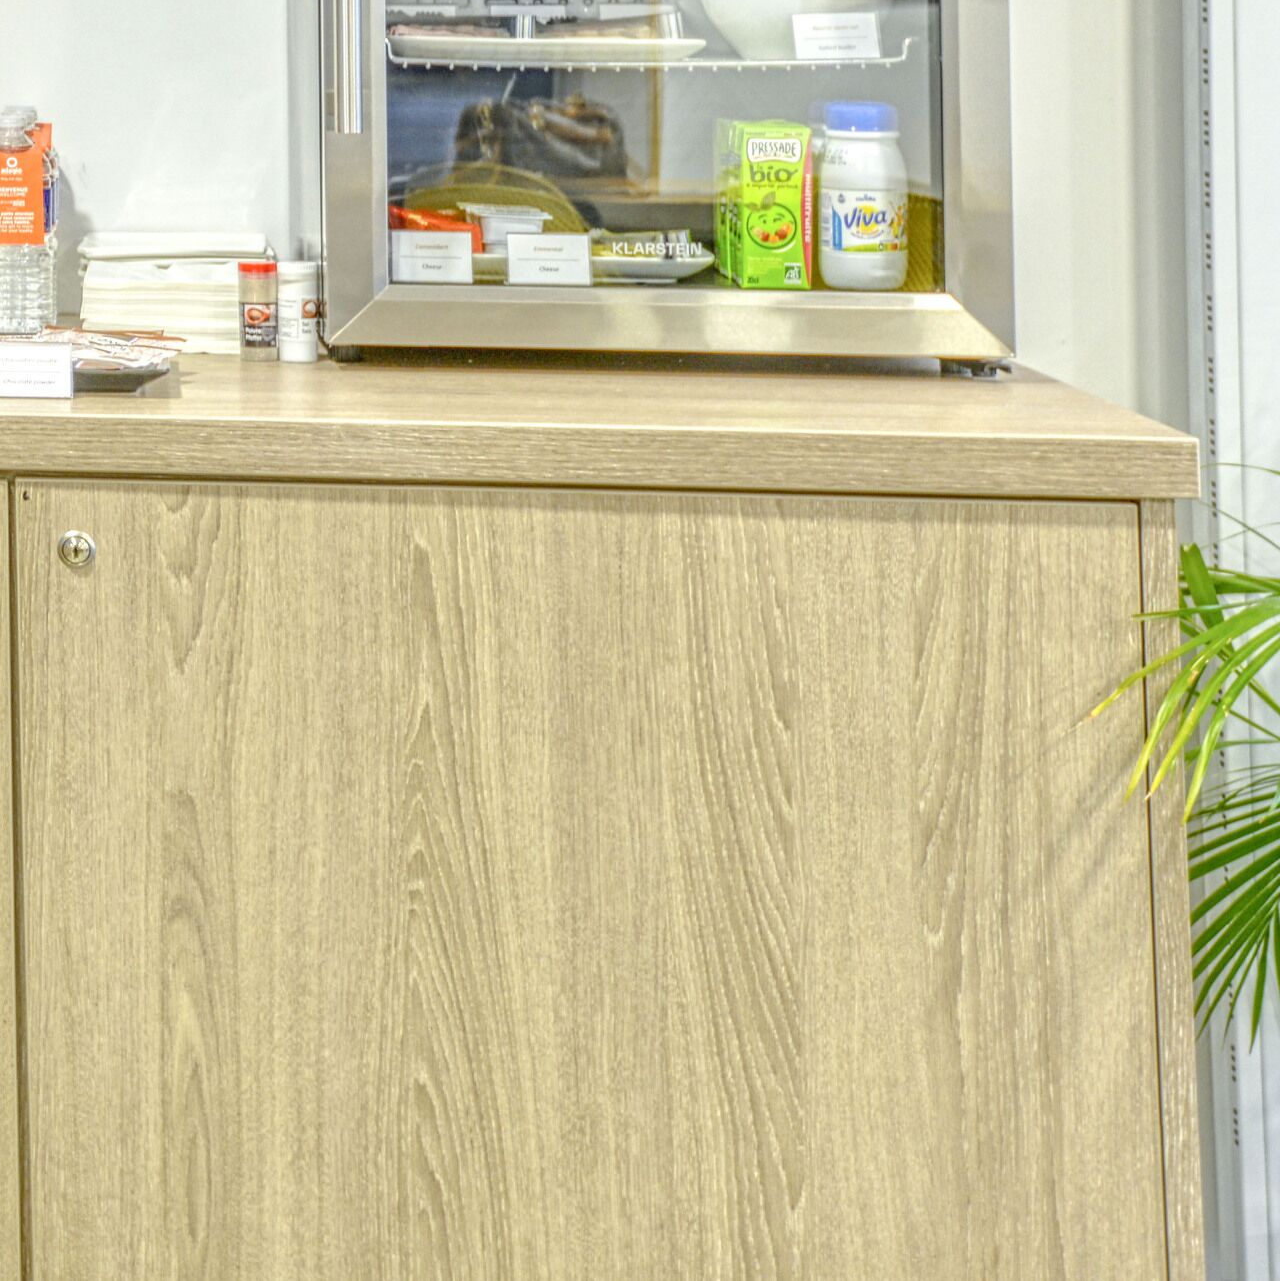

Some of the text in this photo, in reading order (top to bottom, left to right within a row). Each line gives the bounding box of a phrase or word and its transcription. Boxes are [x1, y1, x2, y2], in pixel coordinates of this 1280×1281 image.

[752, 141, 796, 156] PRESSADE
[750, 164, 798, 182] bio
[844, 207, 887, 228] Viva
[612, 242, 702, 256] KLARSTEIN
